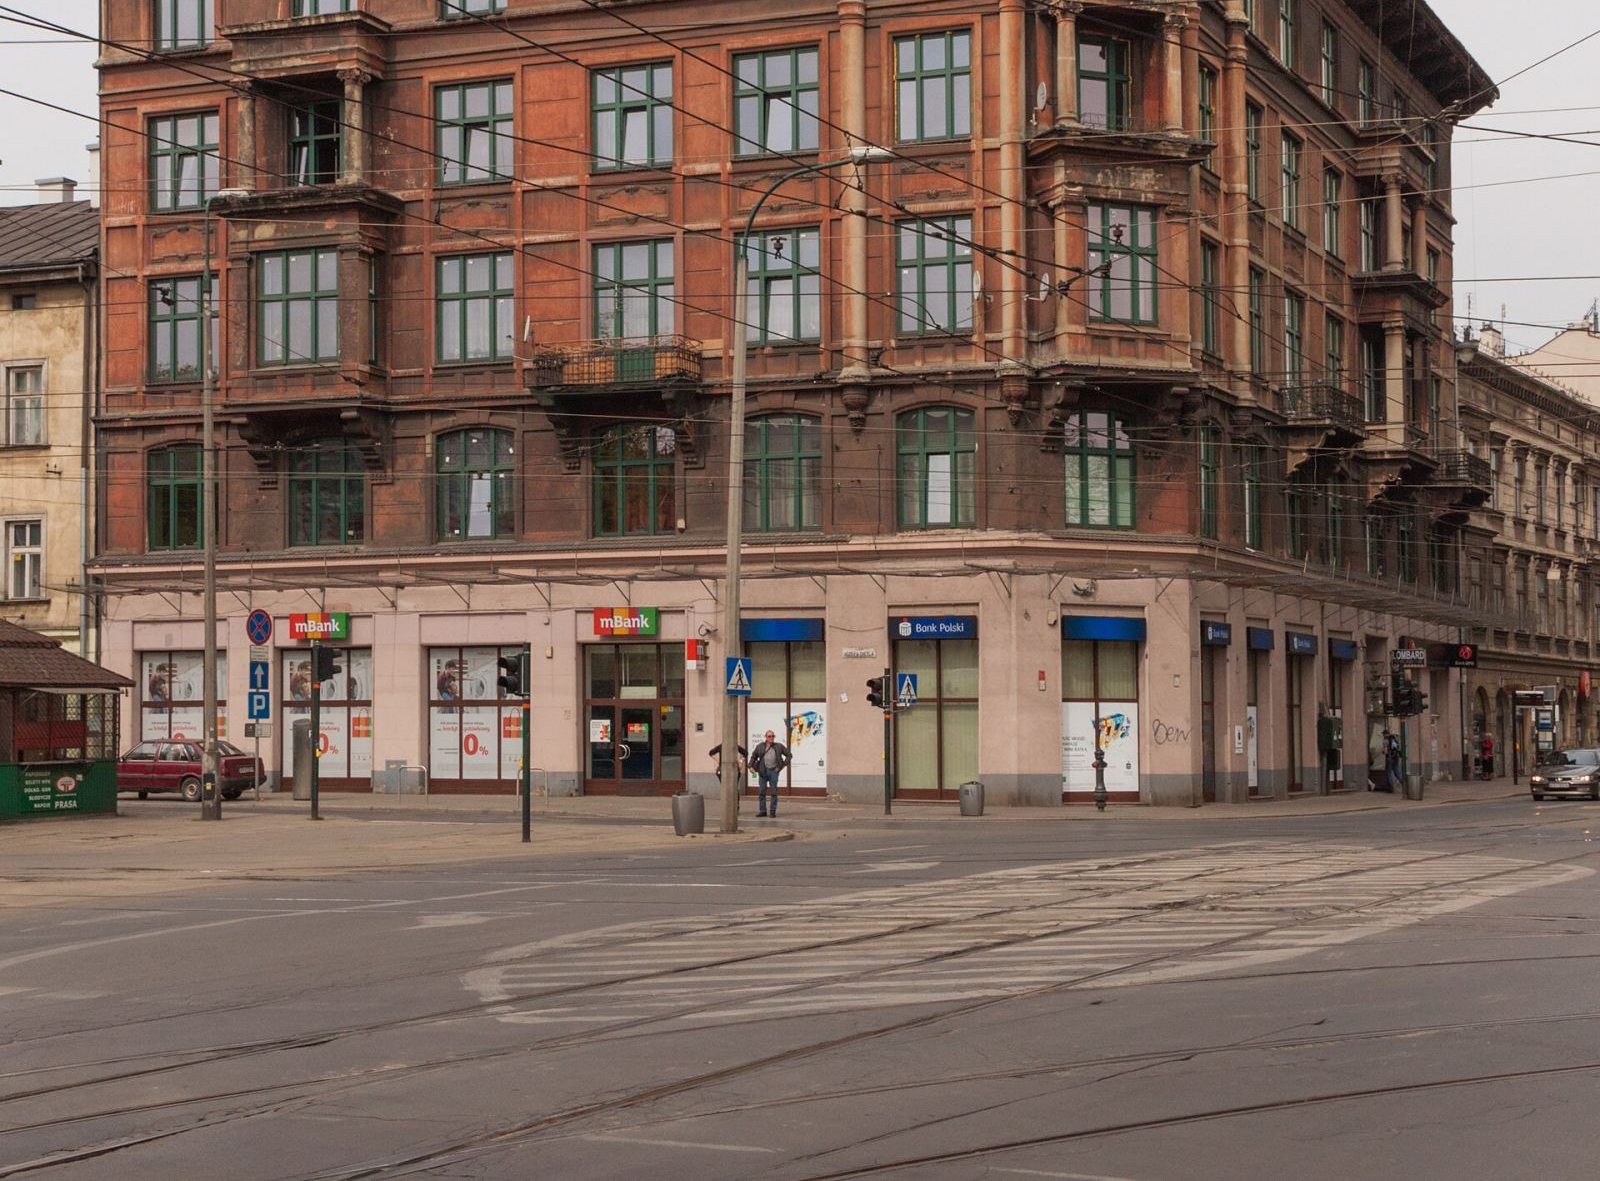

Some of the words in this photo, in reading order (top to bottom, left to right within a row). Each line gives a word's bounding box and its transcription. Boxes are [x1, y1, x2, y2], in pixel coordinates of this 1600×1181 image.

[295, 619, 340, 632] mBank
[600, 614, 650, 628] mBank
[916, 623, 937, 633] Bank
[940, 623, 964, 633] Polski
[1391, 650, 1424, 660] LOMBARD
[253, 694, 266, 716] P
[54, 800, 78, 808] PRASA
